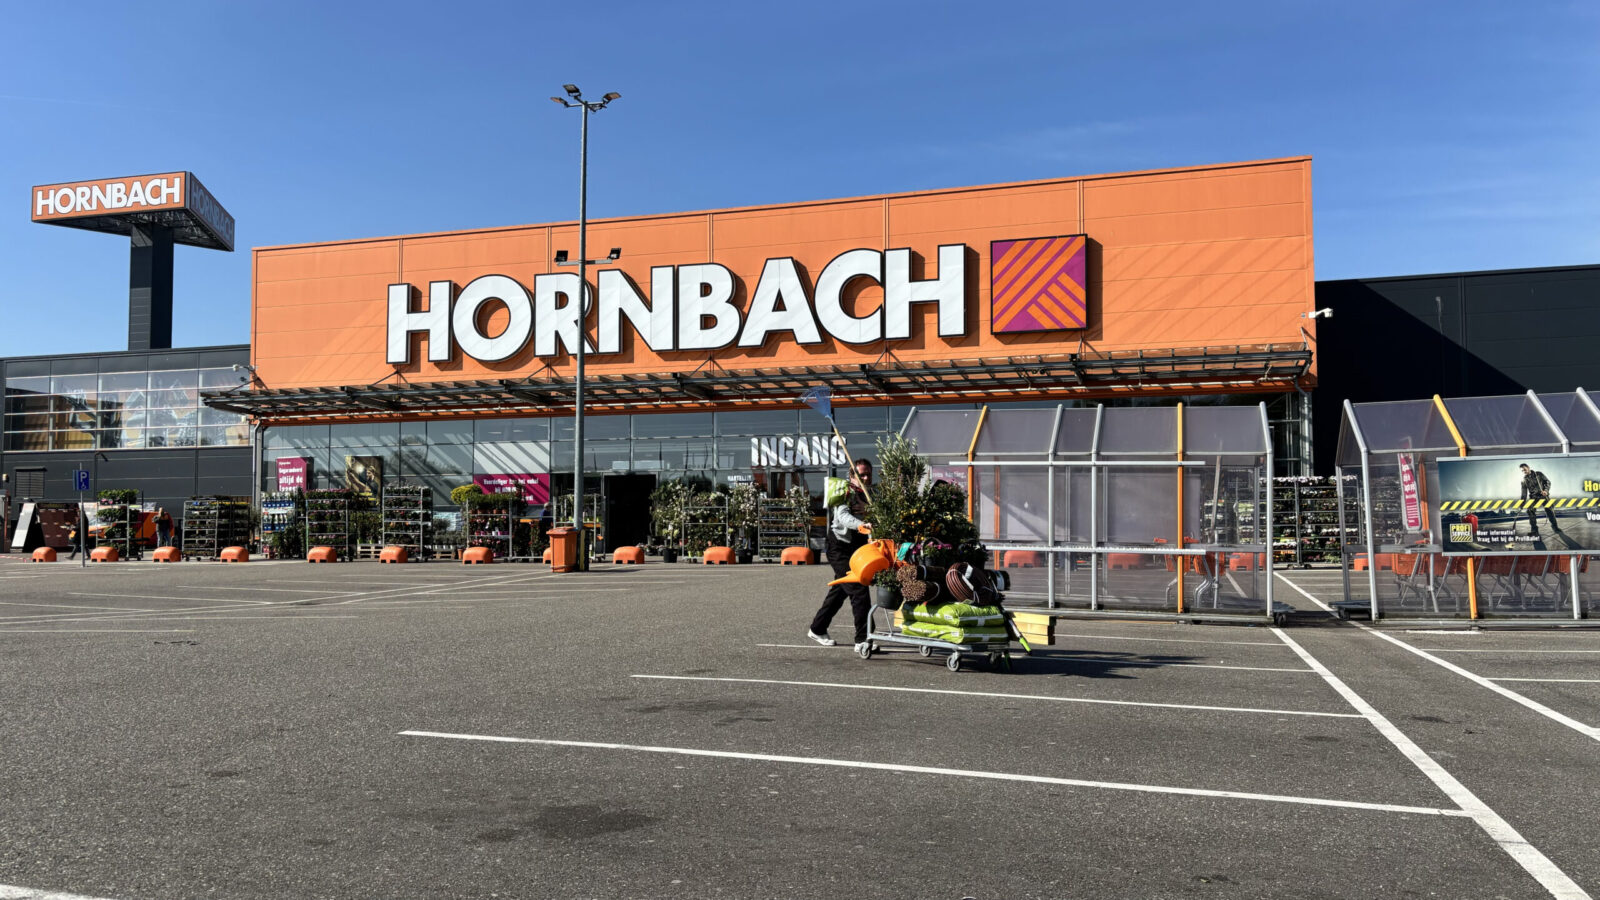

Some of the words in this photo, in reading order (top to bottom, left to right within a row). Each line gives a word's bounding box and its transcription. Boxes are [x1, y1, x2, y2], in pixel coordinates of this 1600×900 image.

[36, 177, 180, 216] HORNBACH
[191, 180, 233, 243] HORNBACH
[387, 243, 966, 364] HORNBACH
[751, 435, 846, 466] INGANG
[80, 471, 88, 482] P
[1584, 480, 1600, 492] Ho
[1452, 524, 1471, 532] PROFI
